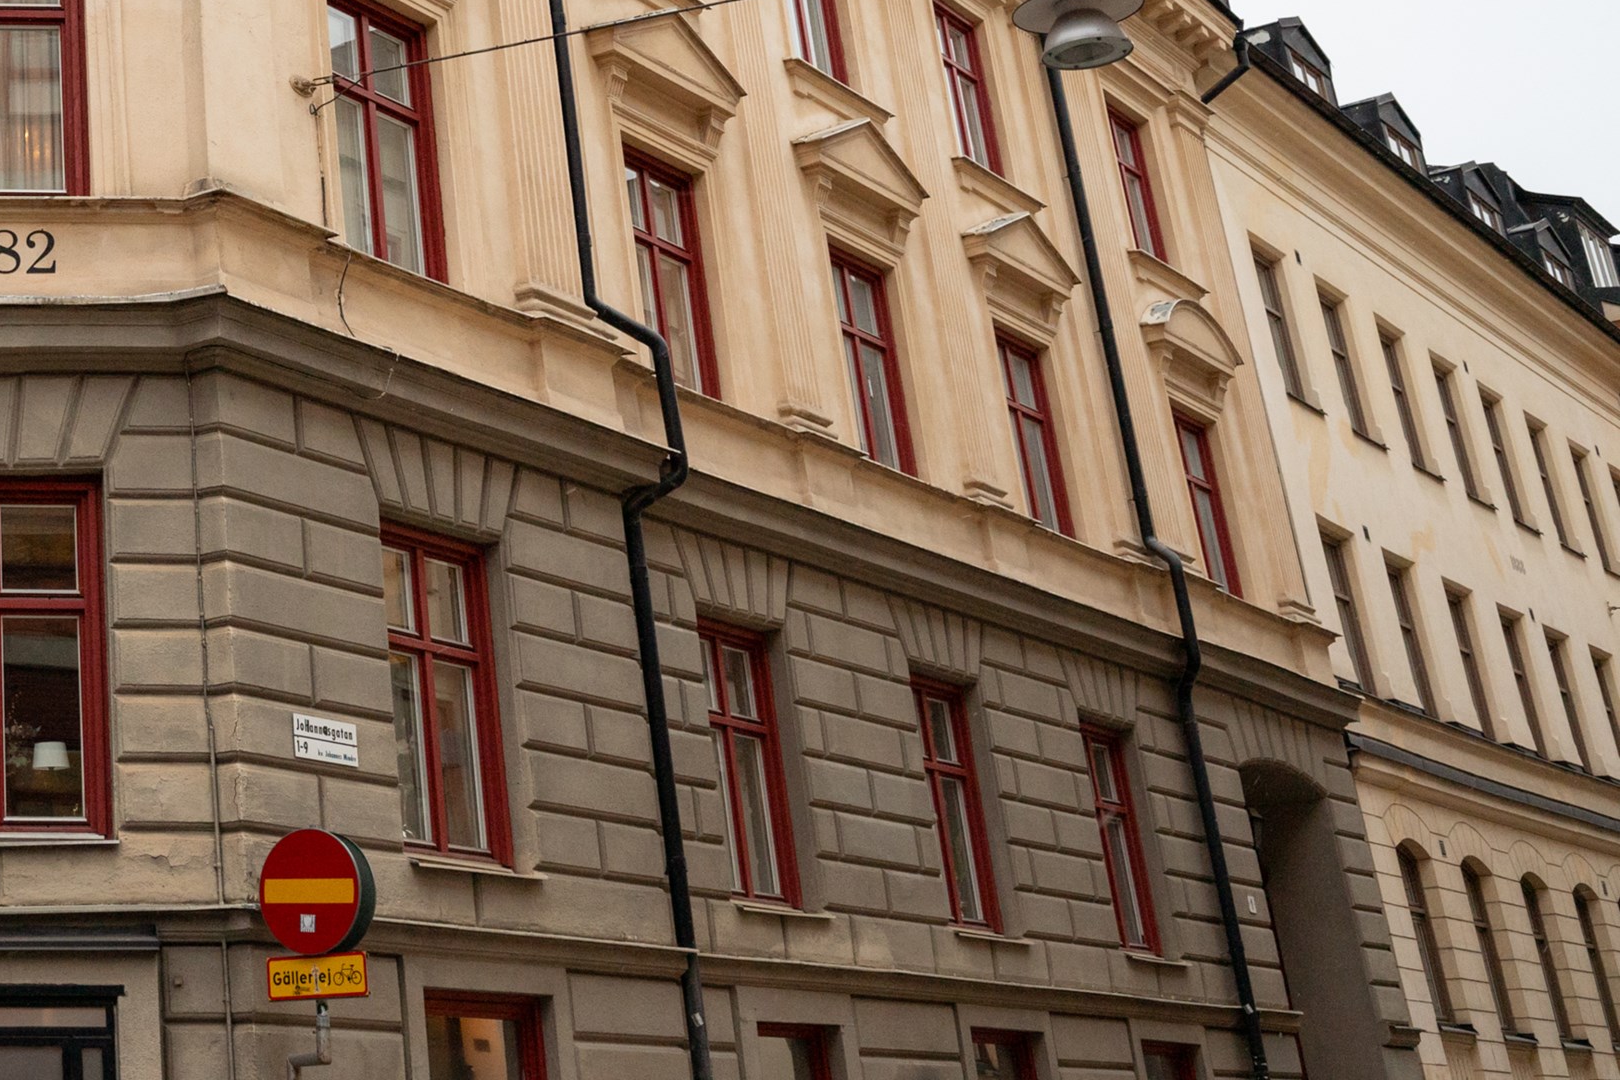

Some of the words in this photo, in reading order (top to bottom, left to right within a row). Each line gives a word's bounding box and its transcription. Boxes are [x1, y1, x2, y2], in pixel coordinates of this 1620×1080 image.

[296, 740, 308, 754] 1-9
[273, 970, 314, 986] Gäller
[318, 968, 331, 986] ej
